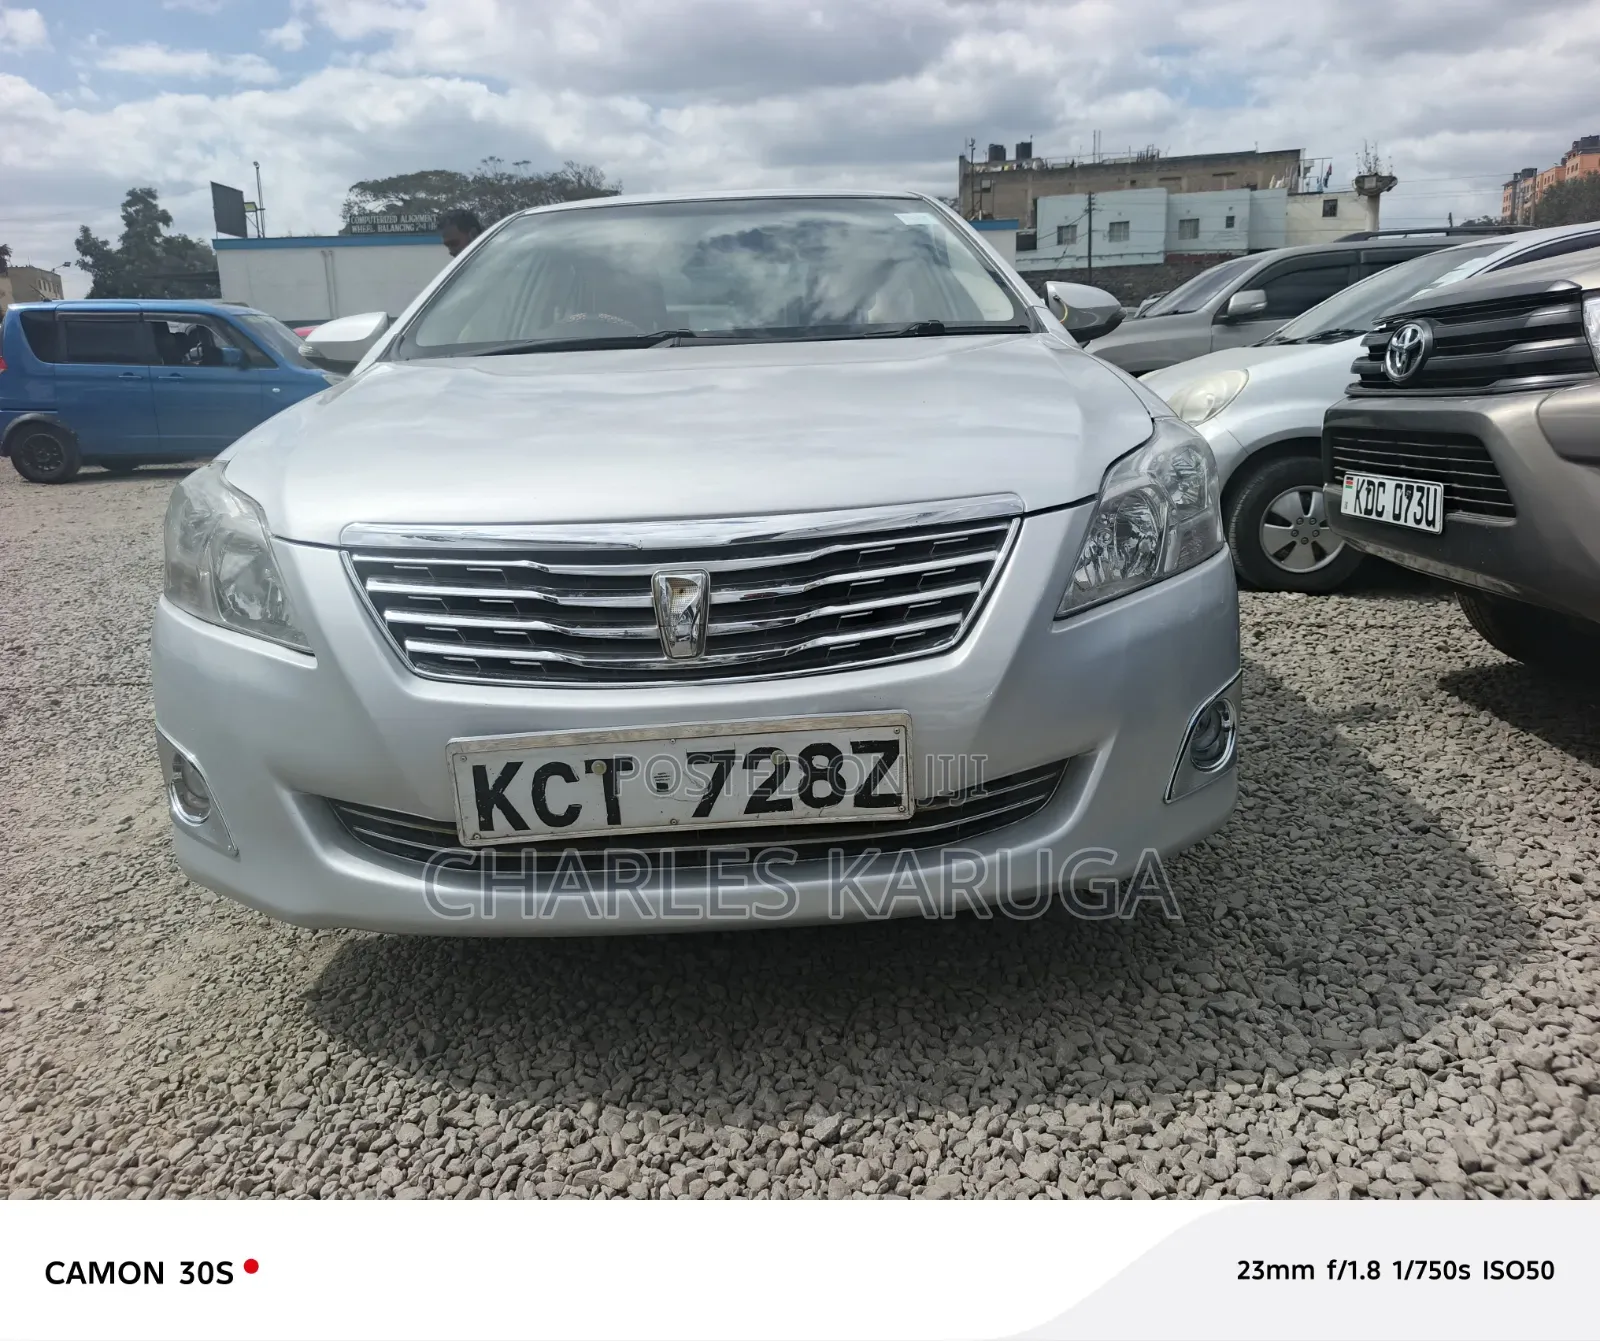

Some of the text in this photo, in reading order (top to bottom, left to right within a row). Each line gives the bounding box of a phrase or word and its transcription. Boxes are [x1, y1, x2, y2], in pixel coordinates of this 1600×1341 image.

[351, 214, 438, 224] COMPUTERIZED ALIGNMENT
[352, 225, 376, 233] WHEEL
[377, 223, 415, 233] BALANCING
[1353, 478, 1438, 528] KDC 073U
[472, 739, 903, 831] KCT 728Z
